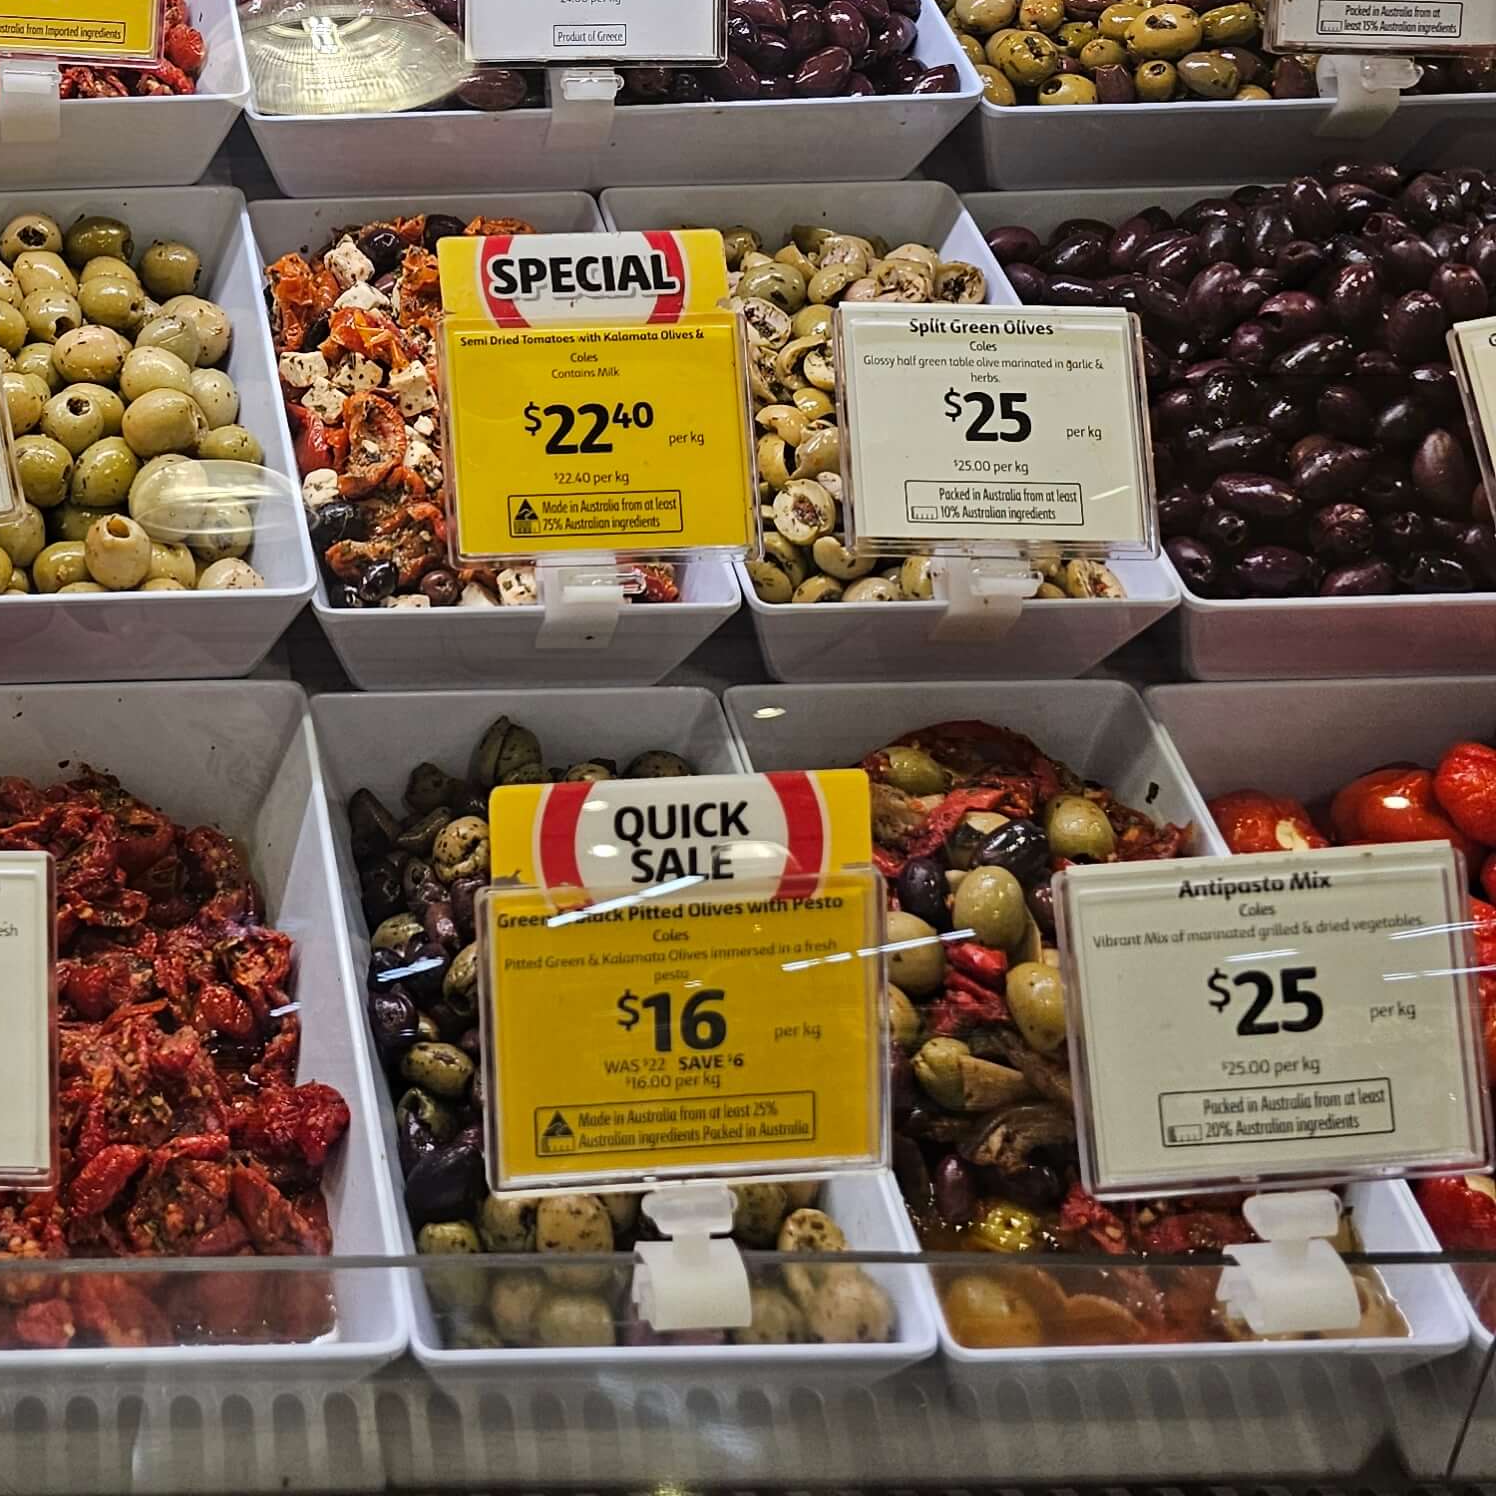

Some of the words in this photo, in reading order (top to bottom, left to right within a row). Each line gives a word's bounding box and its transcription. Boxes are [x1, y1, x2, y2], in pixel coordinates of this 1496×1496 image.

[558, 31, 586, 42] Product
[588, 31, 595, 41] of
[597, 31, 623, 41] Greece
[491, 253, 676, 295] SPECIAL
[461, 335, 488, 346] Semi
[489, 333, 520, 346] Dried
[521, 332, 575, 344] Tomatoes
[578, 332, 601, 342] with
[604, 330, 658, 342] Kalamata
[660, 328, 694, 341] Olives
[695, 328, 704, 339] &
[909, 318, 947, 335] Split
[950, 319, 1000, 334] Green
[1003, 320, 1054, 336] Olives
[969, 341, 998, 352] Coles
[570, 352, 598, 364] Coles
[943, 387, 1032, 443] $25
[668, 433, 688, 446] per
[690, 432, 705, 446] kg
[1066, 427, 1085, 439] per
[1087, 427, 1102, 440] kg
[613, 800, 750, 844] QUICK
[631, 845, 735, 884] SALE
[1178, 878, 1285, 901] Antipasto
[1289, 871, 1332, 891] Mix
[627, 903, 684, 921] Pitted
[688, 900, 744, 919] Olives
[746, 897, 790, 914] with
[792, 895, 844, 911] Pesto
[1239, 903, 1276, 917] Coles
[652, 928, 690, 943] Coles
[1207, 965, 1324, 1037] $25
[616, 989, 728, 1053] $16
[1370, 1005, 1396, 1022] per
[1395, 1002, 1417, 1019] kg
[774, 1025, 800, 1042] per
[801, 1022, 823, 1040] kg
